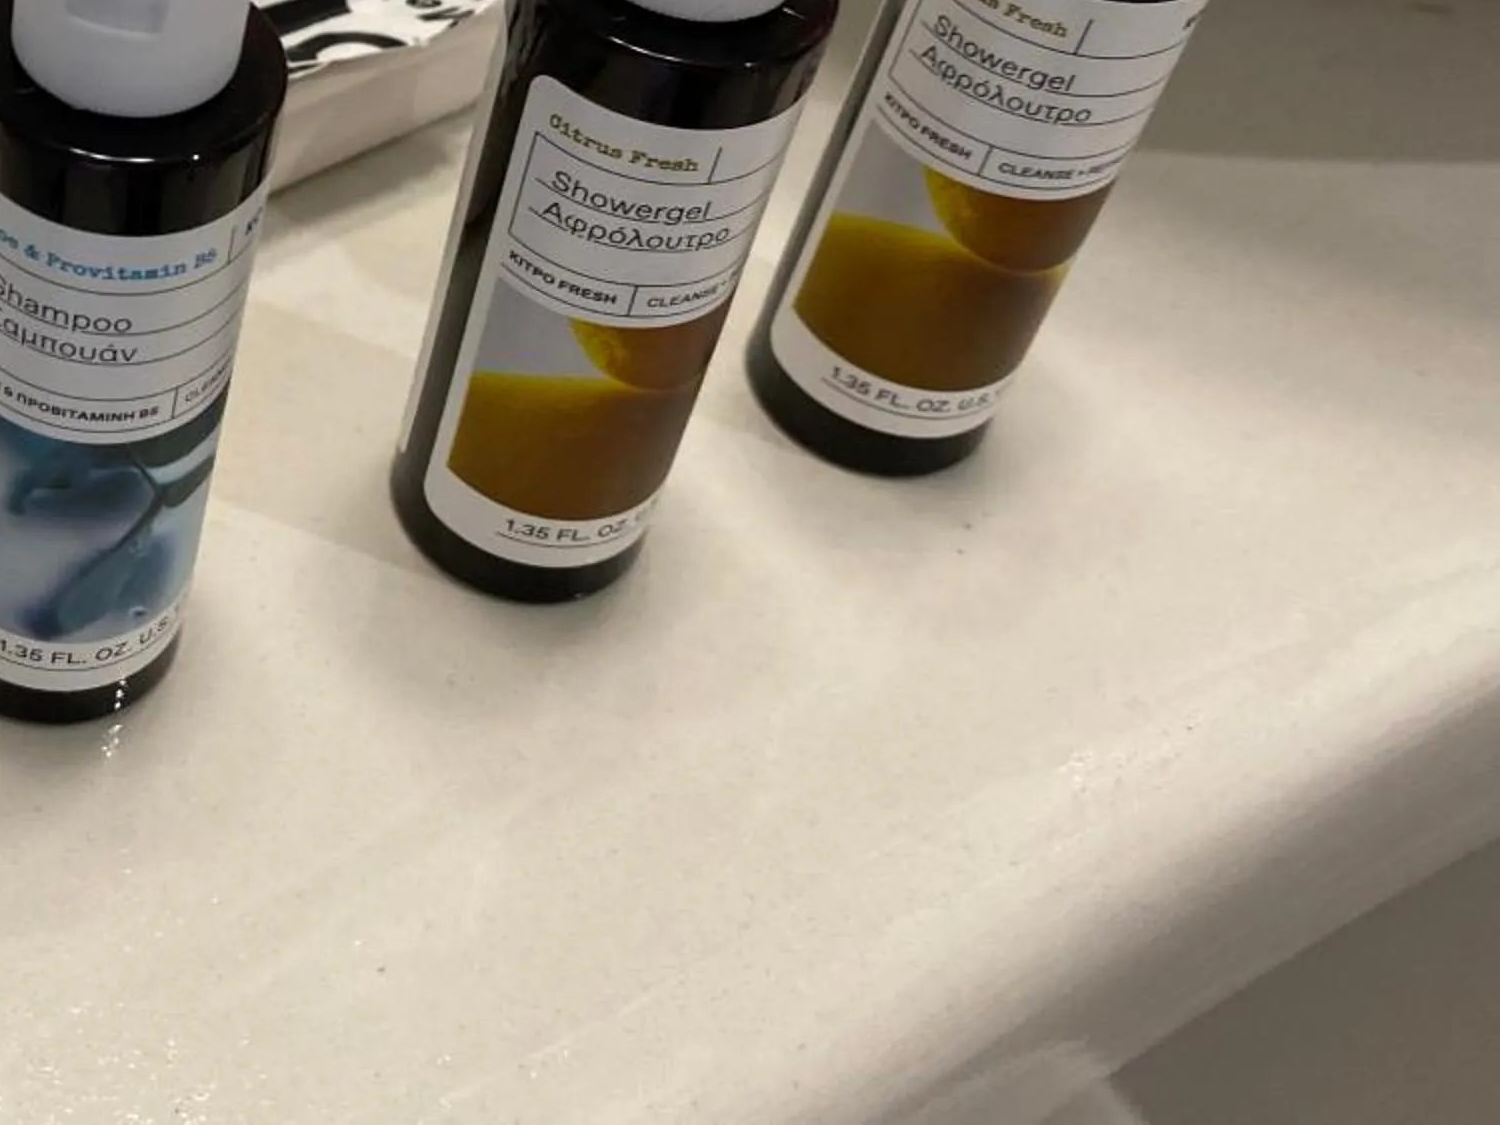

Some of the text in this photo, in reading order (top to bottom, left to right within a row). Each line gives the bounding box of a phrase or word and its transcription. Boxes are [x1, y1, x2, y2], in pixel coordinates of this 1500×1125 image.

[1003, 2, 1068, 39] Fresh
[934, 14, 1077, 92] Showergel
[921, 44, 1092, 125] Αφρόλουτρο
[549, 113, 700, 173] Citrus Fresh
[920, 126, 973, 160] FRESH
[997, 161, 1074, 180] CLEANSE
[550, 169, 713, 227] Showergel
[542, 201, 731, 252] Αφρόλουτρο
[46, 251, 188, 281] Provitamin
[557, 277, 619, 305] FRESH
[505, 518, 549, 540] 1.35
[0, 638, 43, 662] 1.35
